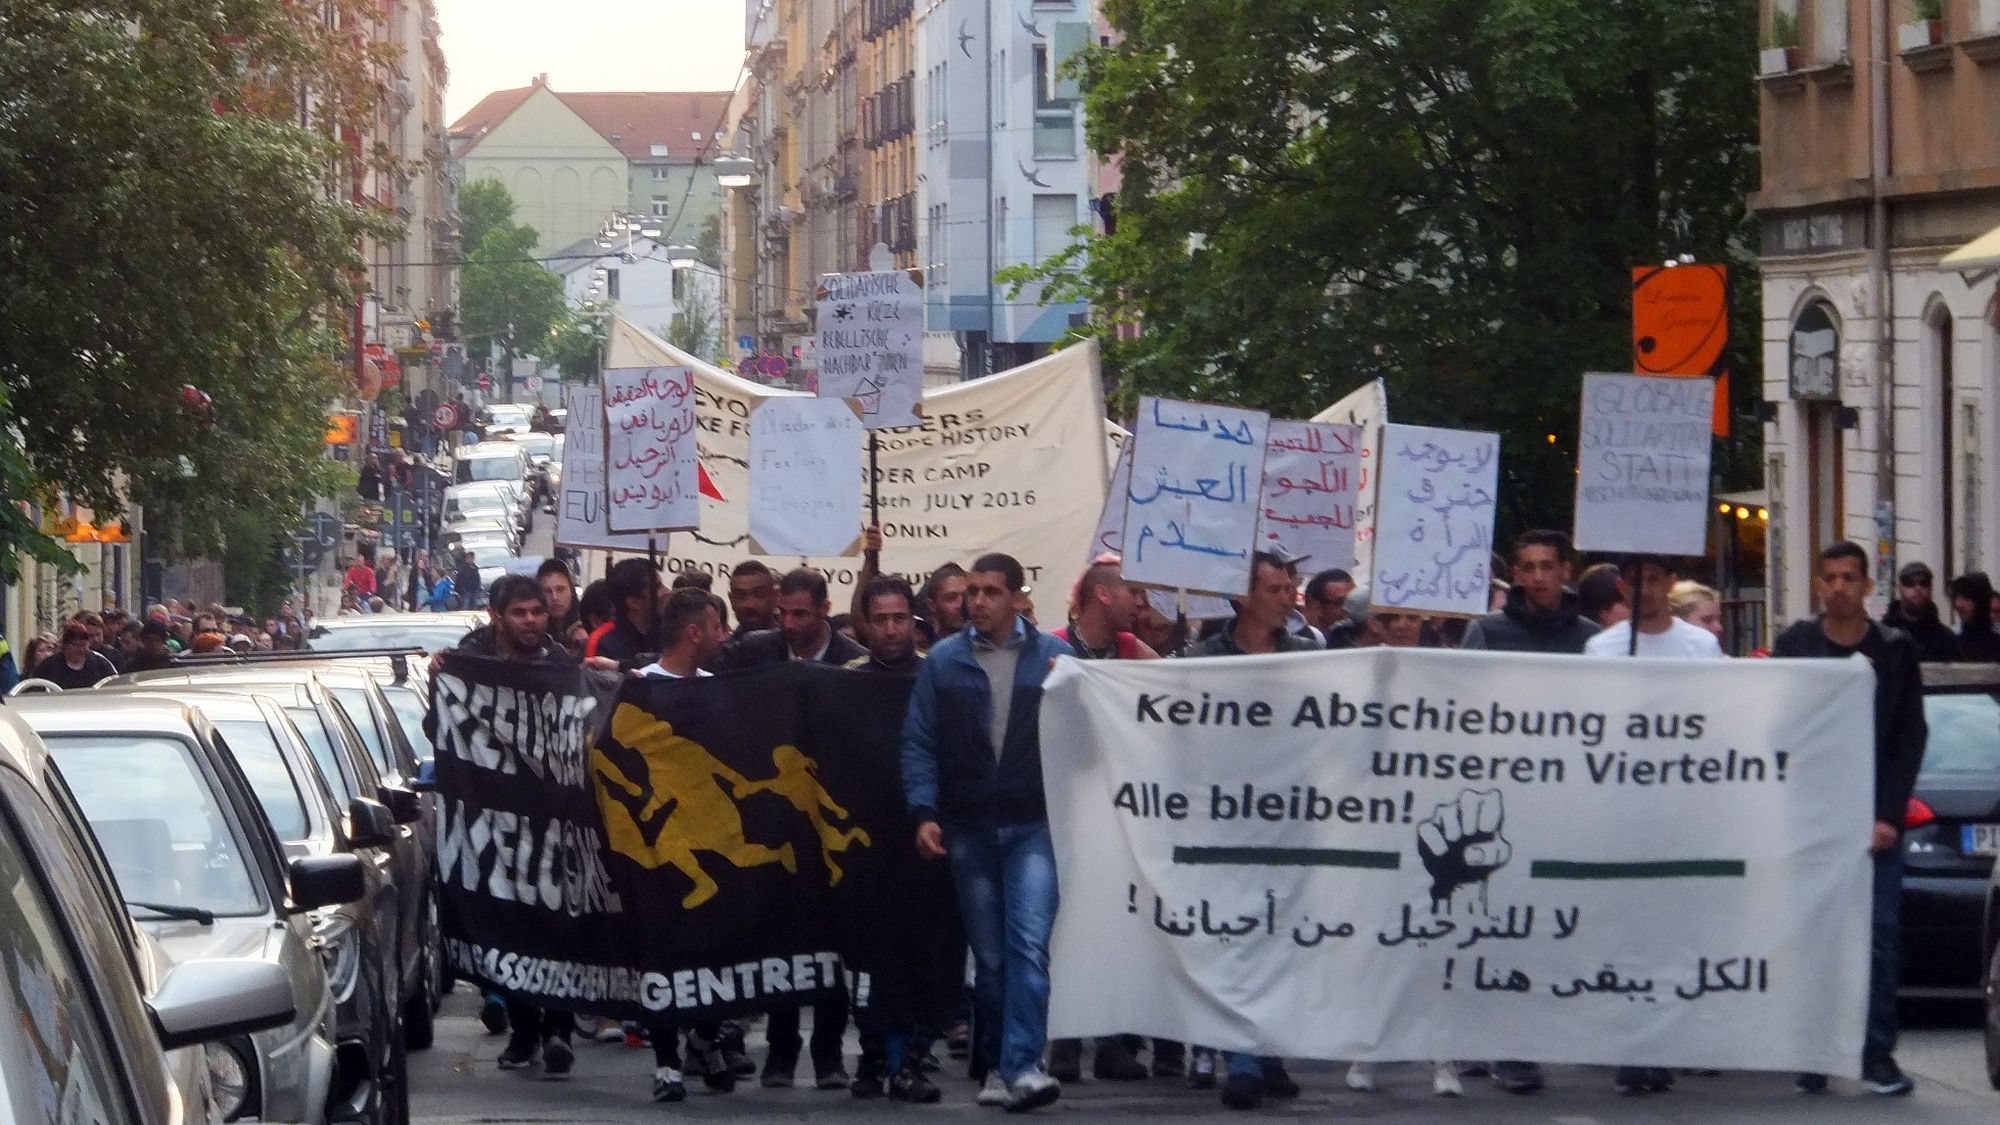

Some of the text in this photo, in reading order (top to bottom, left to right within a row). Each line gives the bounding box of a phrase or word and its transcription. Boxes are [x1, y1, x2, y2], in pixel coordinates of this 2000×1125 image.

[942, 423, 1031, 446] HISTORY
[924, 462, 992, 483] CAMP
[1599, 451, 1692, 484] STATT
[923, 493, 974, 512] JULY
[982, 490, 1037, 510] 2016
[1136, 691, 1707, 747] Keine Abschiebung aus
[1371, 748, 1790, 786] unseren Vierteln!
[1113, 782, 1415, 825] Alle bleiben!
[1292, 914, 1356, 947] من
[1553, 905, 1580, 940] لا
[1474, 956, 1532, 993] هنا
[1551, 962, 1653, 1003] يبقى
[1674, 956, 1769, 1001] الكل
